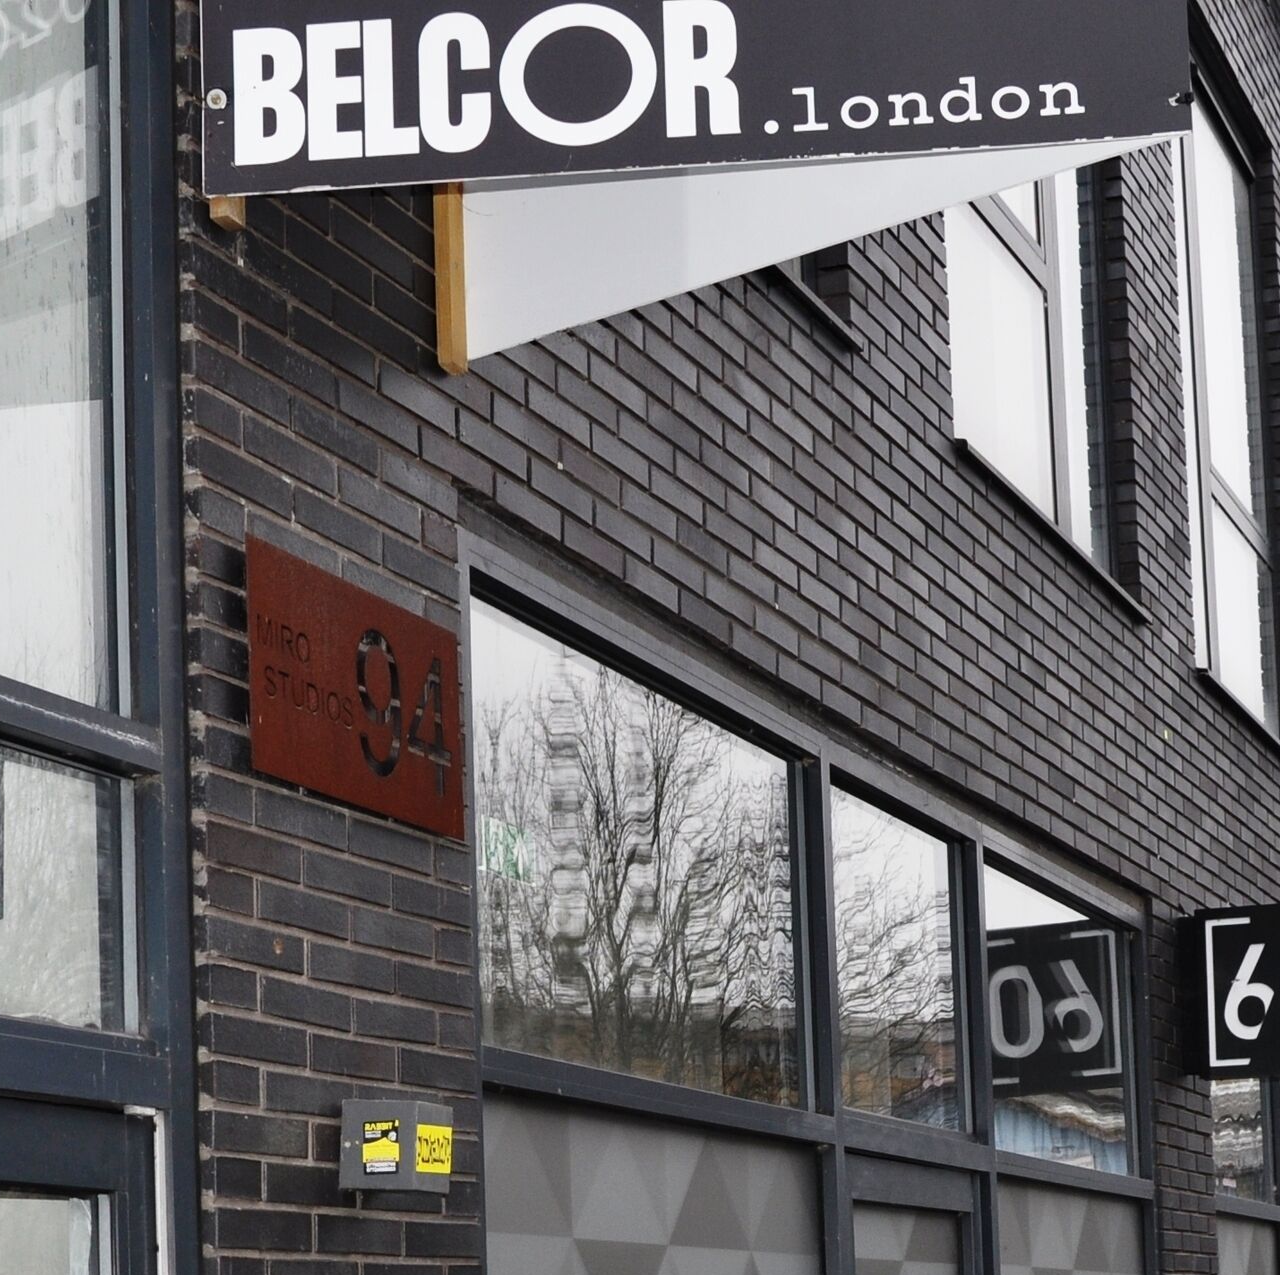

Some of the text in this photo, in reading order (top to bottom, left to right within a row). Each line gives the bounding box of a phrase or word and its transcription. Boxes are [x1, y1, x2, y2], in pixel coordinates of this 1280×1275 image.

[231, 0, 741, 166] BELCOR
[256, 612, 311, 664] MIRO
[263, 665, 353, 730] STUDIOS
[356, 627, 452, 798] 94
